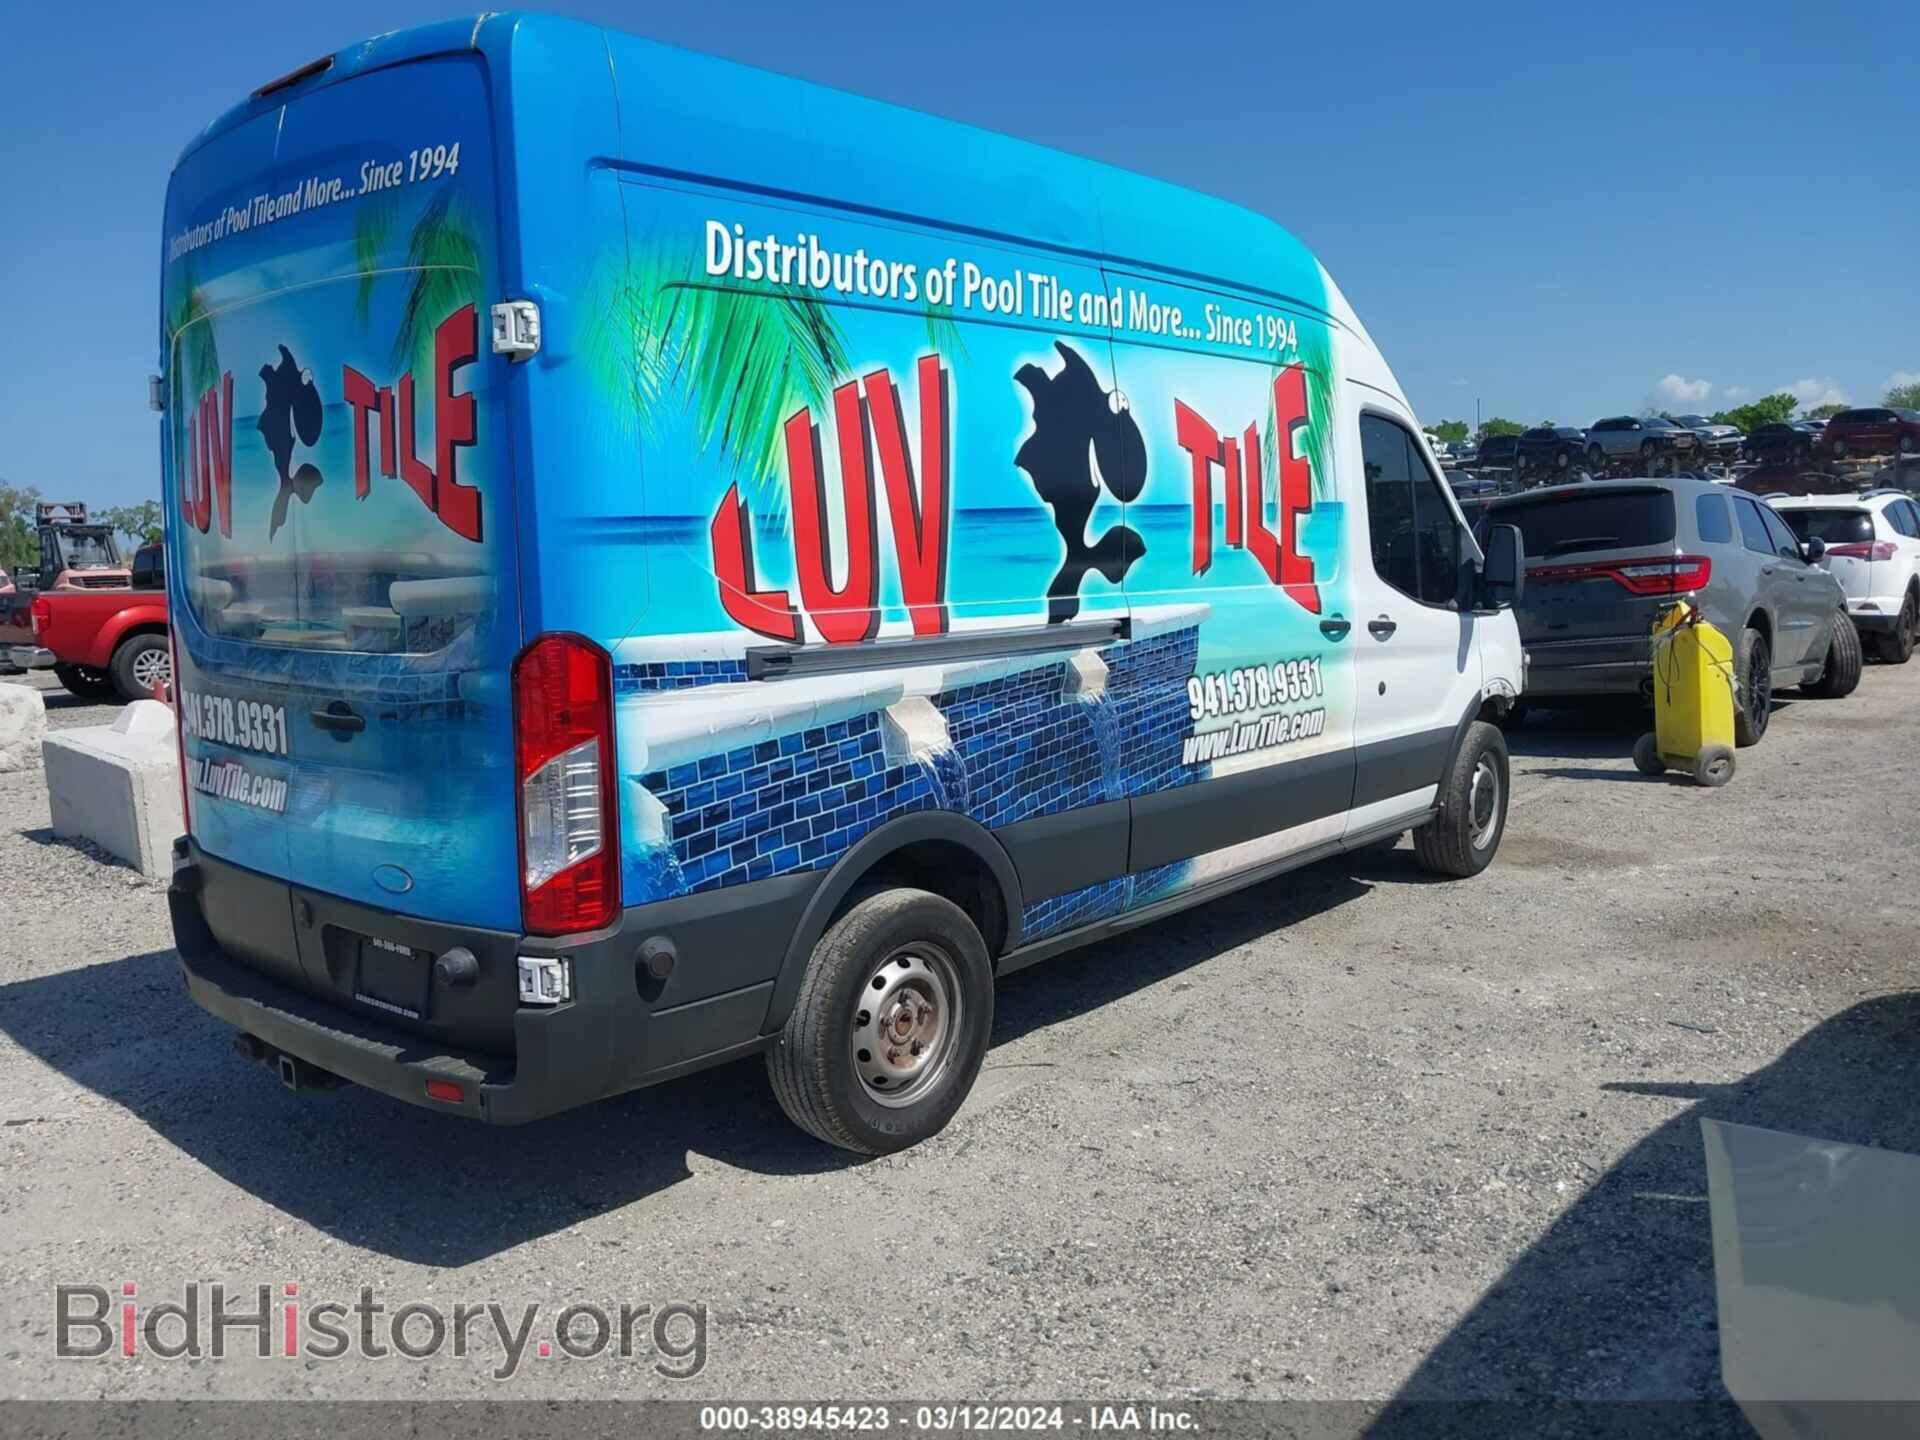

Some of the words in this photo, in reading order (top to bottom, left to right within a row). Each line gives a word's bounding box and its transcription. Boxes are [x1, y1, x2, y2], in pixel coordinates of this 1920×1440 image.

[214, 208, 228, 240] of
[226, 199, 252, 235] Pool
[359, 160, 403, 195] Since
[409, 142, 460, 182] 1994
[705, 219, 918, 302] Distributors
[924, 258, 956, 306] of
[963, 261, 1022, 314] Pool
[1028, 271, 1074, 322] Tile
[1079, 287, 1124, 329] and
[1129, 290, 1201, 339] More...
[1205, 303, 1251, 346] Since
[1256, 313, 1298, 353] 1994
[343, 303, 483, 543] TILE
[711, 353, 948, 645] LUV
[1175, 362, 1322, 615] TILE
[1182, 708, 1325, 765] www.LuvTile.com
[1186, 655, 1323, 720] 941.378.9331
